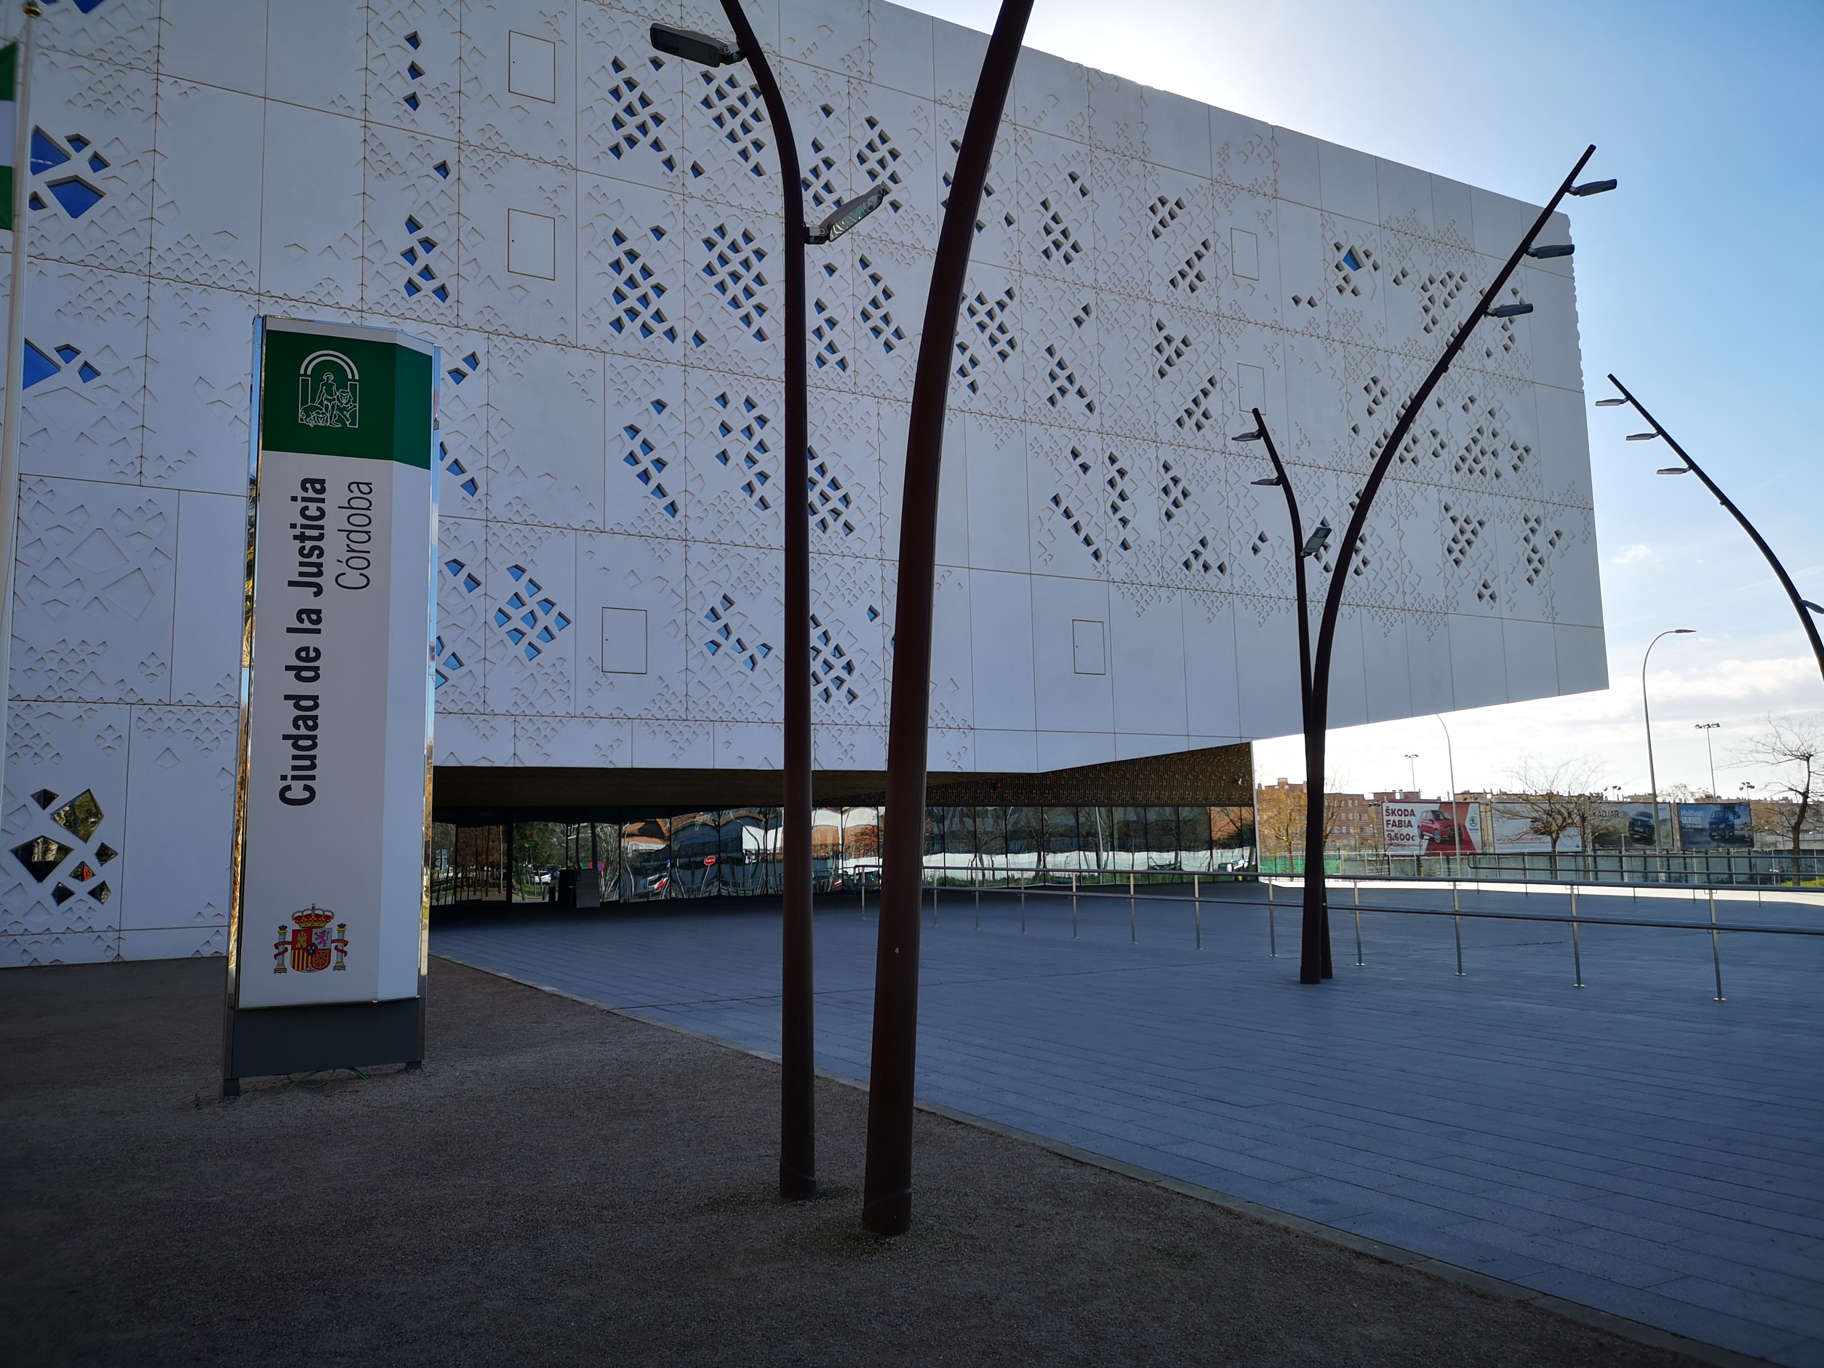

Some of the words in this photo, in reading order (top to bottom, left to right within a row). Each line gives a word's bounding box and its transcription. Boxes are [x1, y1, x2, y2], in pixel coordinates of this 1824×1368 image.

[287, 477, 327, 598] Justicia
[334, 481, 373, 591] Córdoba
[285, 607, 323, 635] la
[284, 645, 322, 684] de
[278, 693, 321, 807] Ciudad
[1385, 806, 1416, 817] ŠKODA
[1386, 819, 1413, 828] FABIA
